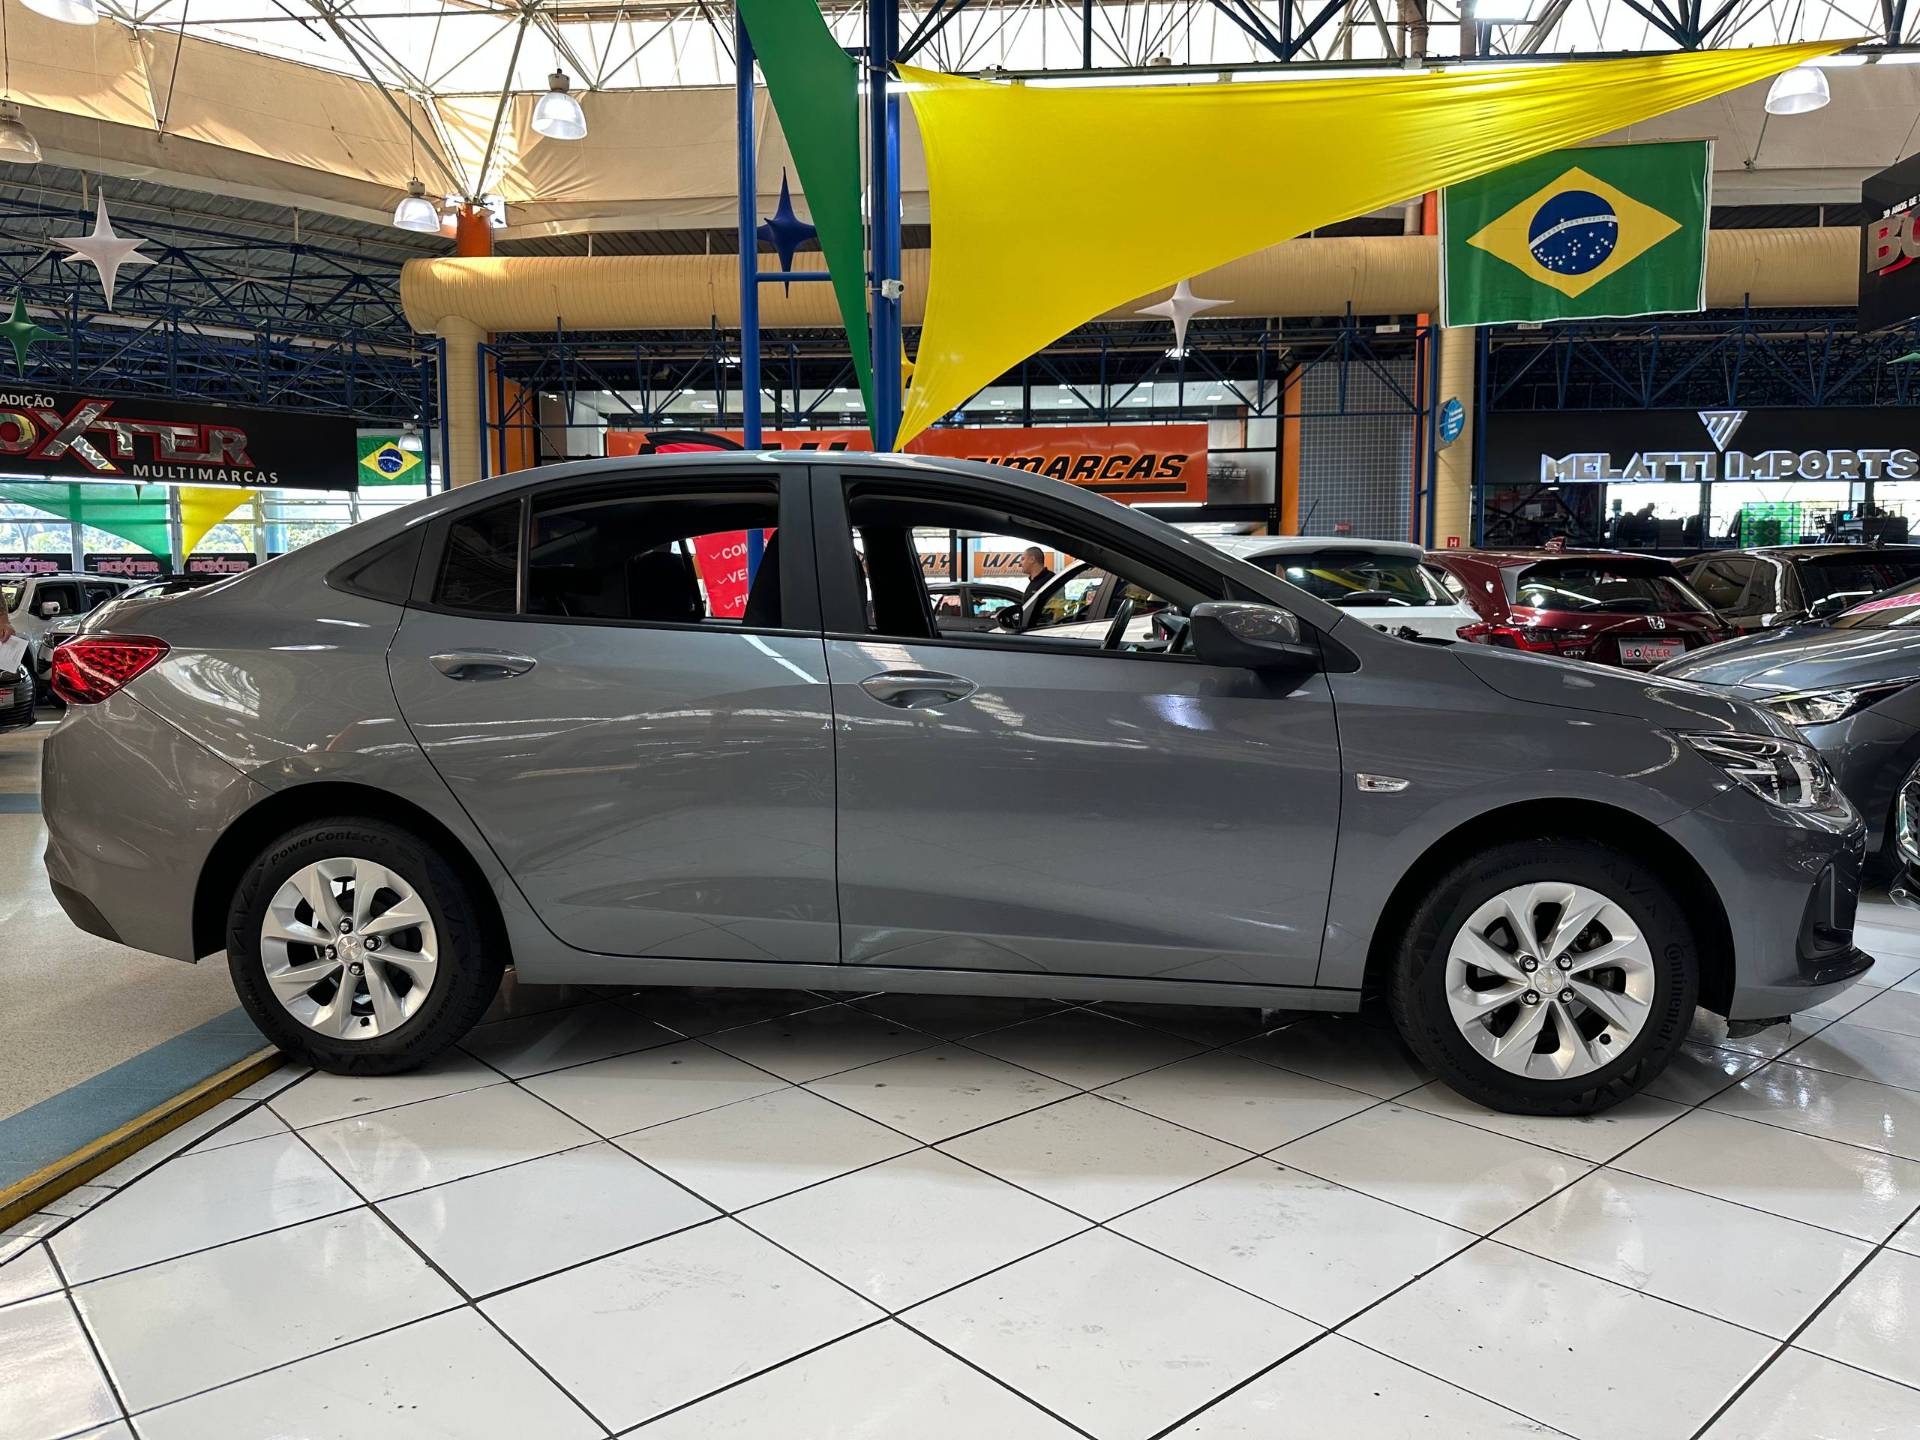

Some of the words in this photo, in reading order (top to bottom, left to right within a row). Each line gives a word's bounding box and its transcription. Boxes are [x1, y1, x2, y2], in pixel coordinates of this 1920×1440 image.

[132, 463, 279, 484] MULTIMARCAS
[1540, 451, 1718, 483] MELATTI
[1724, 449, 1920, 481] IMPORTS
[1625, 643, 1672, 664] BOXTER
